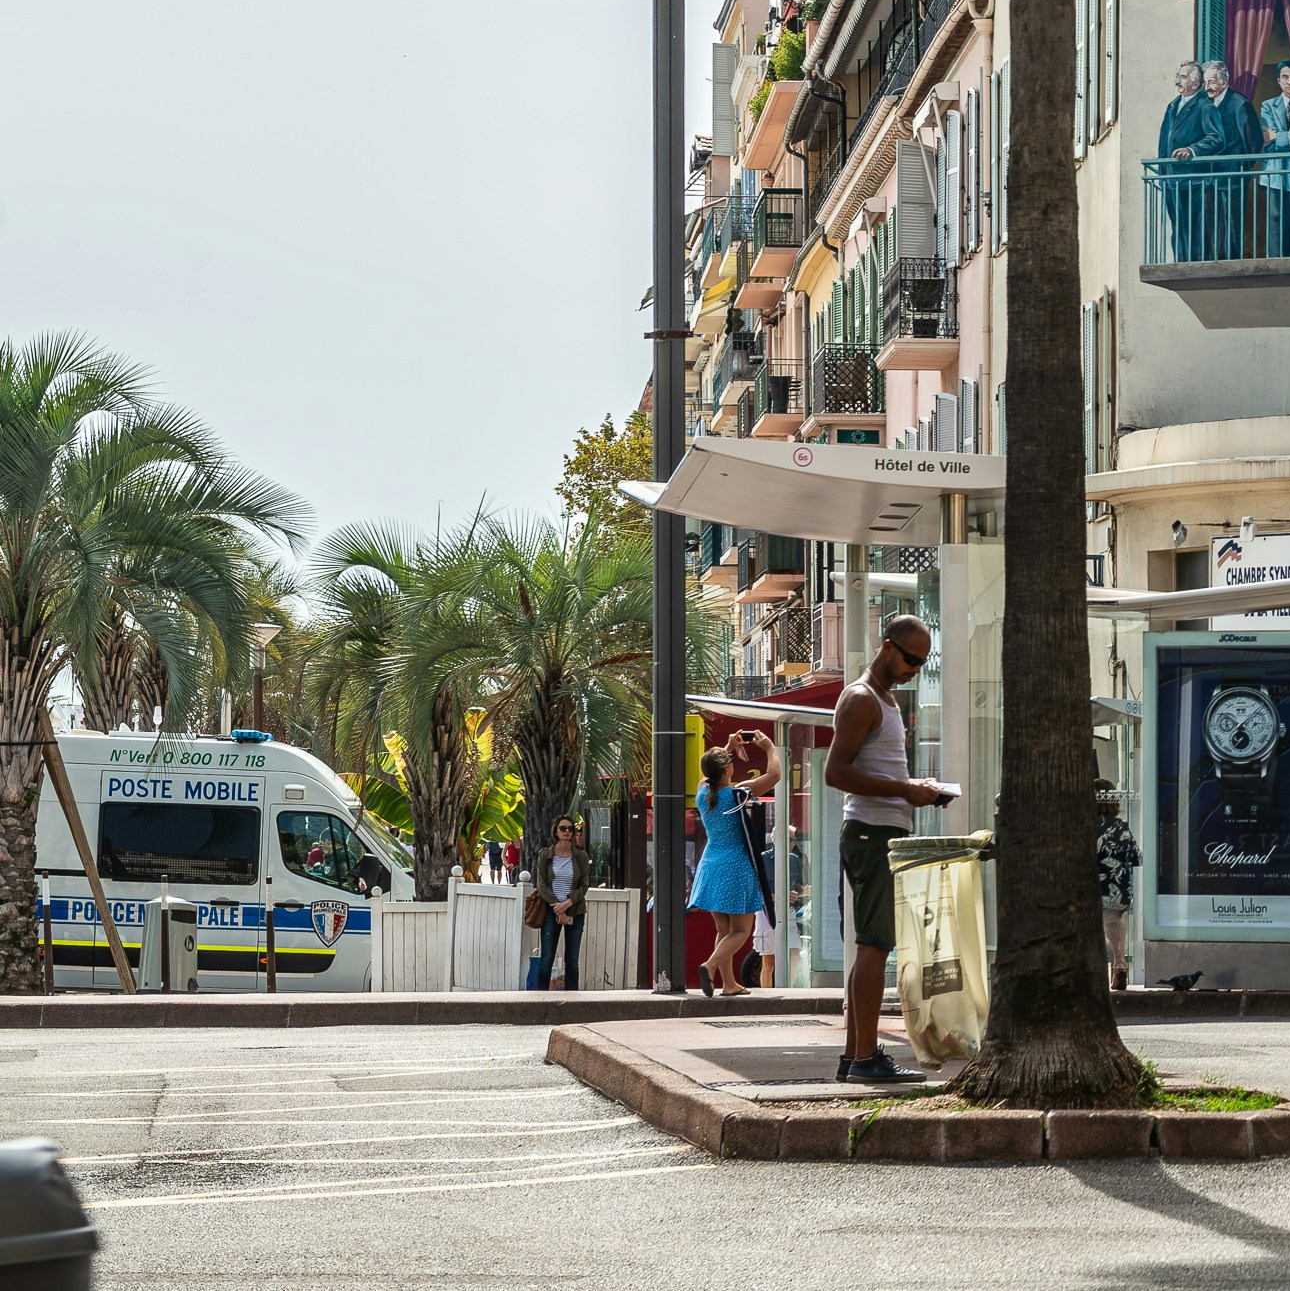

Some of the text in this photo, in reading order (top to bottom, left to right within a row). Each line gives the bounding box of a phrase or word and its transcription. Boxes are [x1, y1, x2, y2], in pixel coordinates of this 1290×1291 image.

[875, 459, 913, 472] Hôtel
[917, 460, 935, 472] de
[940, 461, 971, 474] Ville
[1226, 567, 1267, 586] CHAMBRE
[1218, 634, 1257, 643] JCDecaux
[163, 752, 174, 764] 0
[180, 753, 212, 766] 800
[218, 754, 239, 767] 117
[244, 755, 266, 768] 118
[108, 778, 260, 802] POSTE MOBILE
[1204, 842, 1277, 869] Chopard
[313, 907, 347, 915] MUNICIPALE
[1211, 898, 1268, 914] Louis Julian
